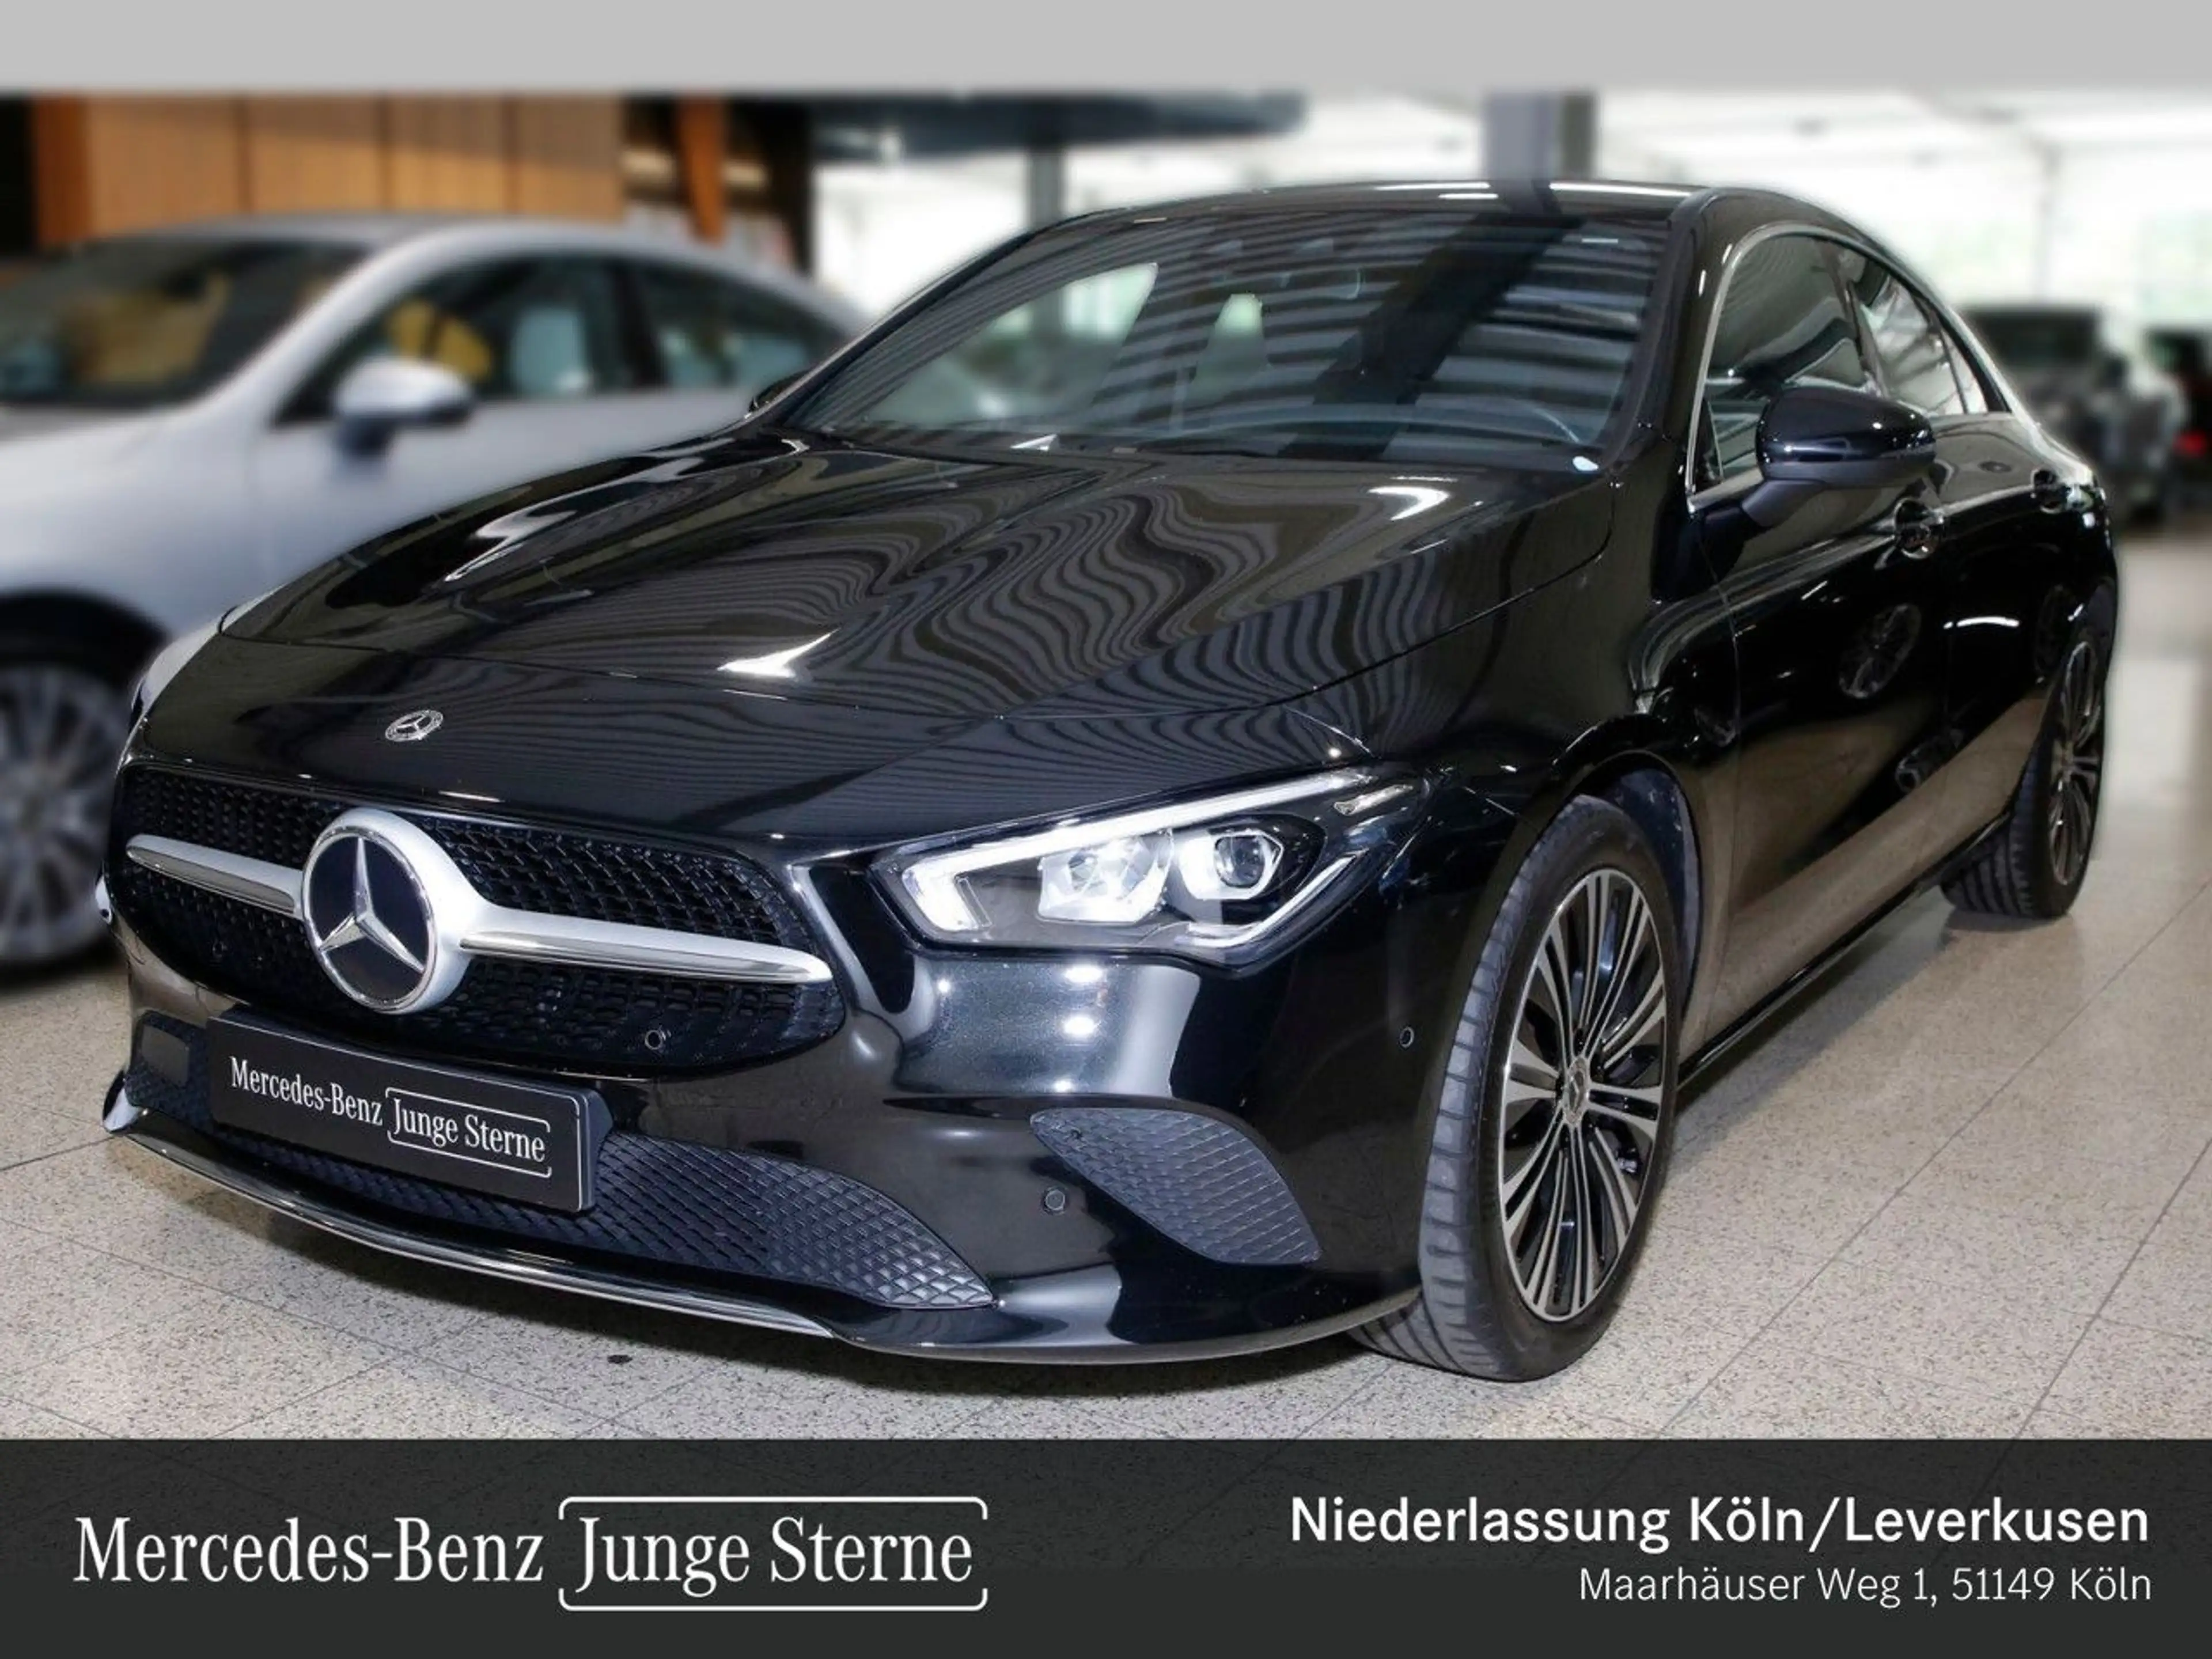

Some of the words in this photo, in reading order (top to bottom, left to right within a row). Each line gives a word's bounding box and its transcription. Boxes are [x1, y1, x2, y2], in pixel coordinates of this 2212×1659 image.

[229, 1056, 383, 1126] Mercedes-Benz
[393, 1097, 459, 1147] Junge
[465, 1115, 547, 1162] Sterne
